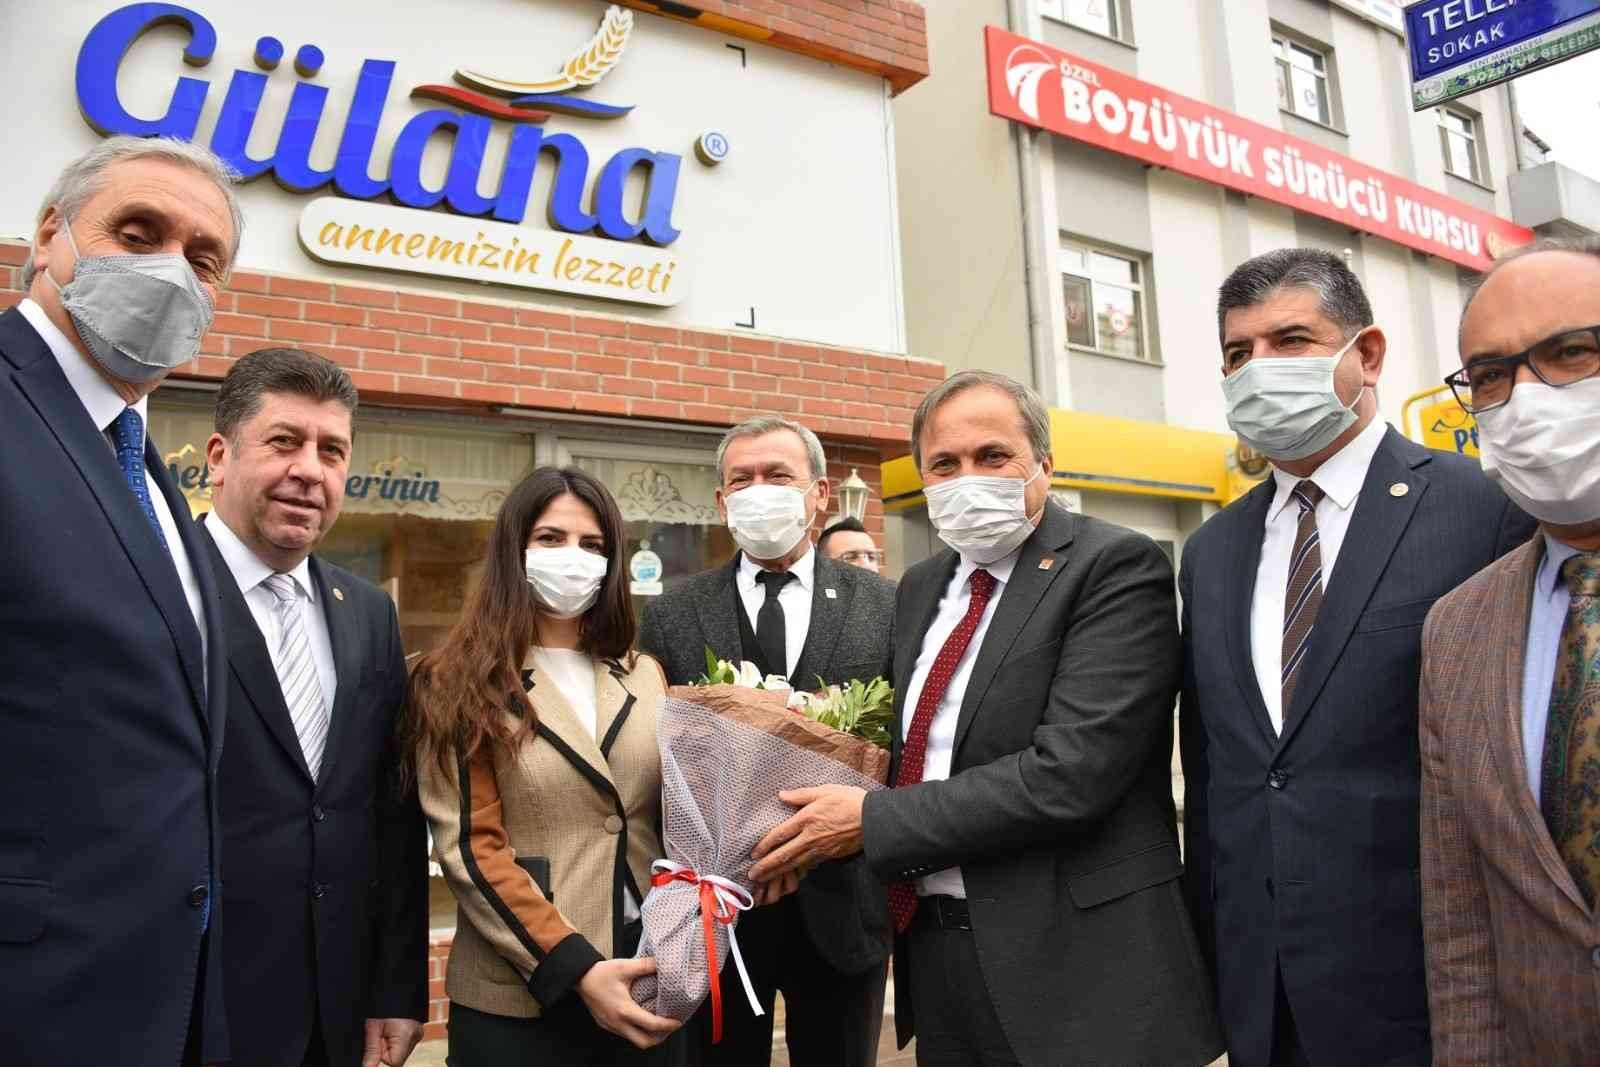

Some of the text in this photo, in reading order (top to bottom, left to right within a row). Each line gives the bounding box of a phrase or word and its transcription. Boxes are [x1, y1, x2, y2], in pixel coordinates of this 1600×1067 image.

[1428, 21, 1505, 64] SOKAK
[1060, 58, 1102, 88] ÖZEL
[75, 2, 683, 247] Gülana
[1060, 76, 1480, 256] BOZÜYÜK SÜRÜCÜ KURSU
[318, 220, 677, 293] annemizin lezzeti
[344, 470, 440, 503] erinin
